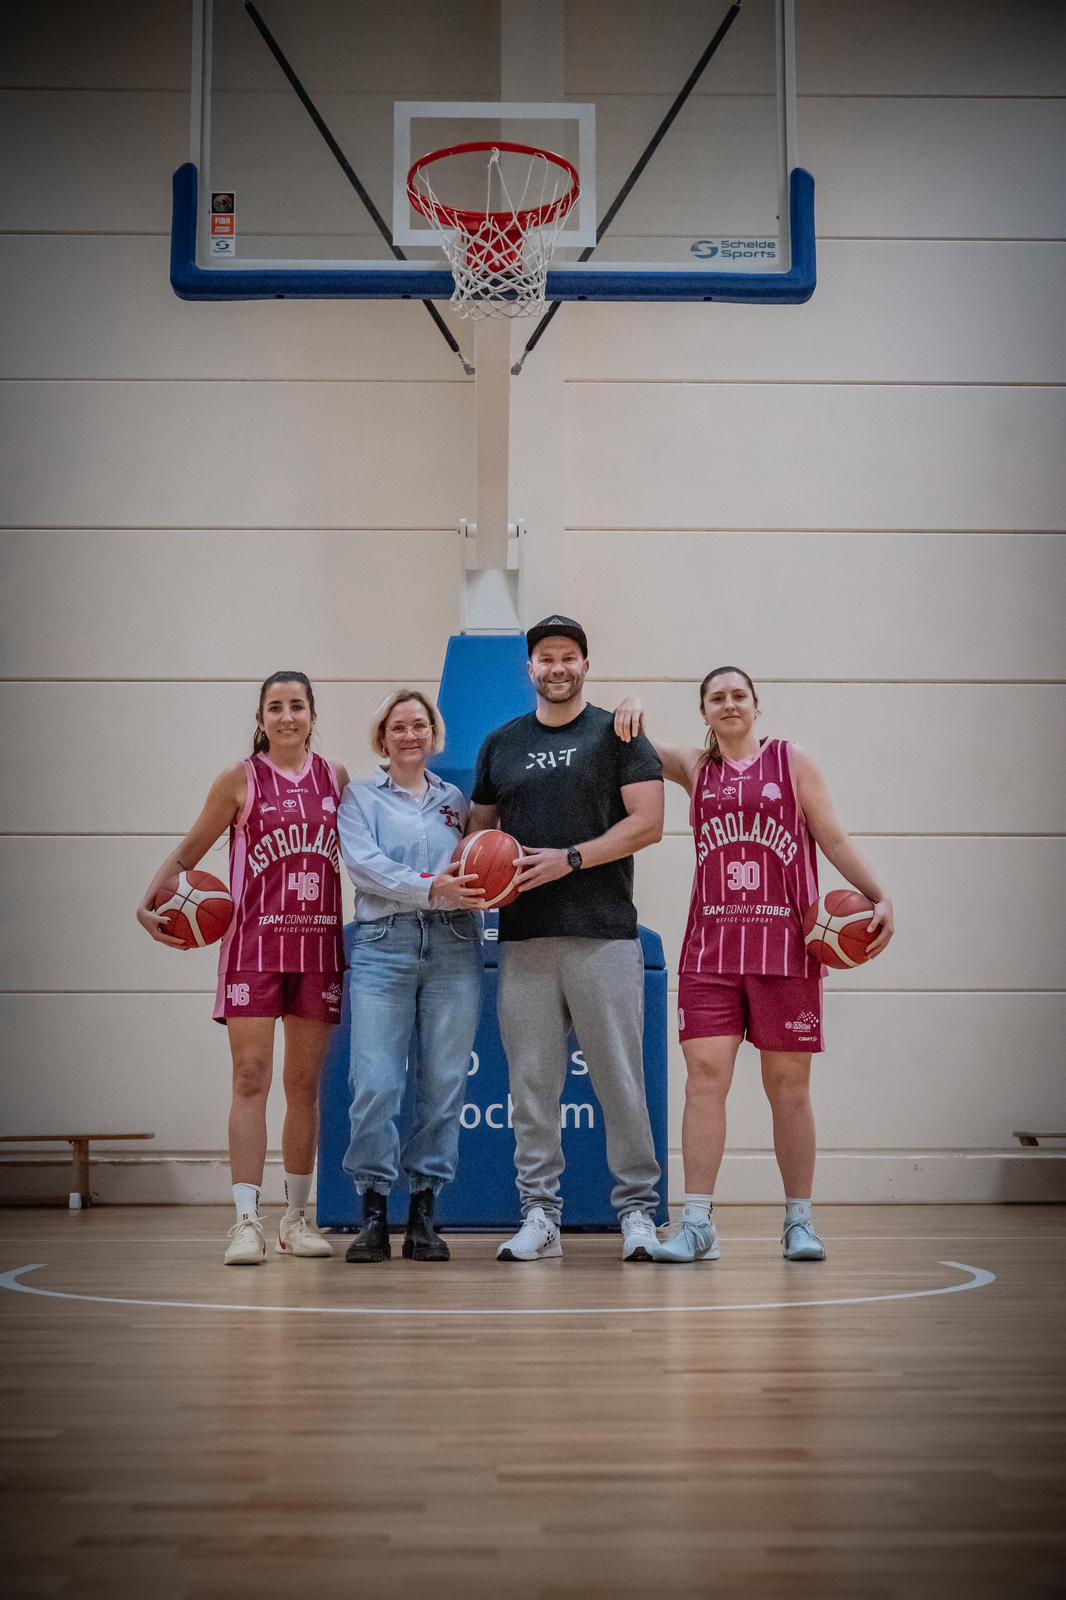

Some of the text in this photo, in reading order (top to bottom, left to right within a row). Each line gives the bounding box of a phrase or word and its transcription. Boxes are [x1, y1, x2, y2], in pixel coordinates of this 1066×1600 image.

[720, 240, 776, 249] Schelde
[720, 249, 776, 260] Sports
[525, 747, 577, 770] CRAFT
[727, 861, 760, 891] 30
[288, 872, 320, 901] 46
[725, 904, 755, 915] CONNY
[755, 904, 791, 917] STOBER
[258, 914, 338, 926] TEAM CONNY STOBER
[226, 979, 250, 1007] 46
